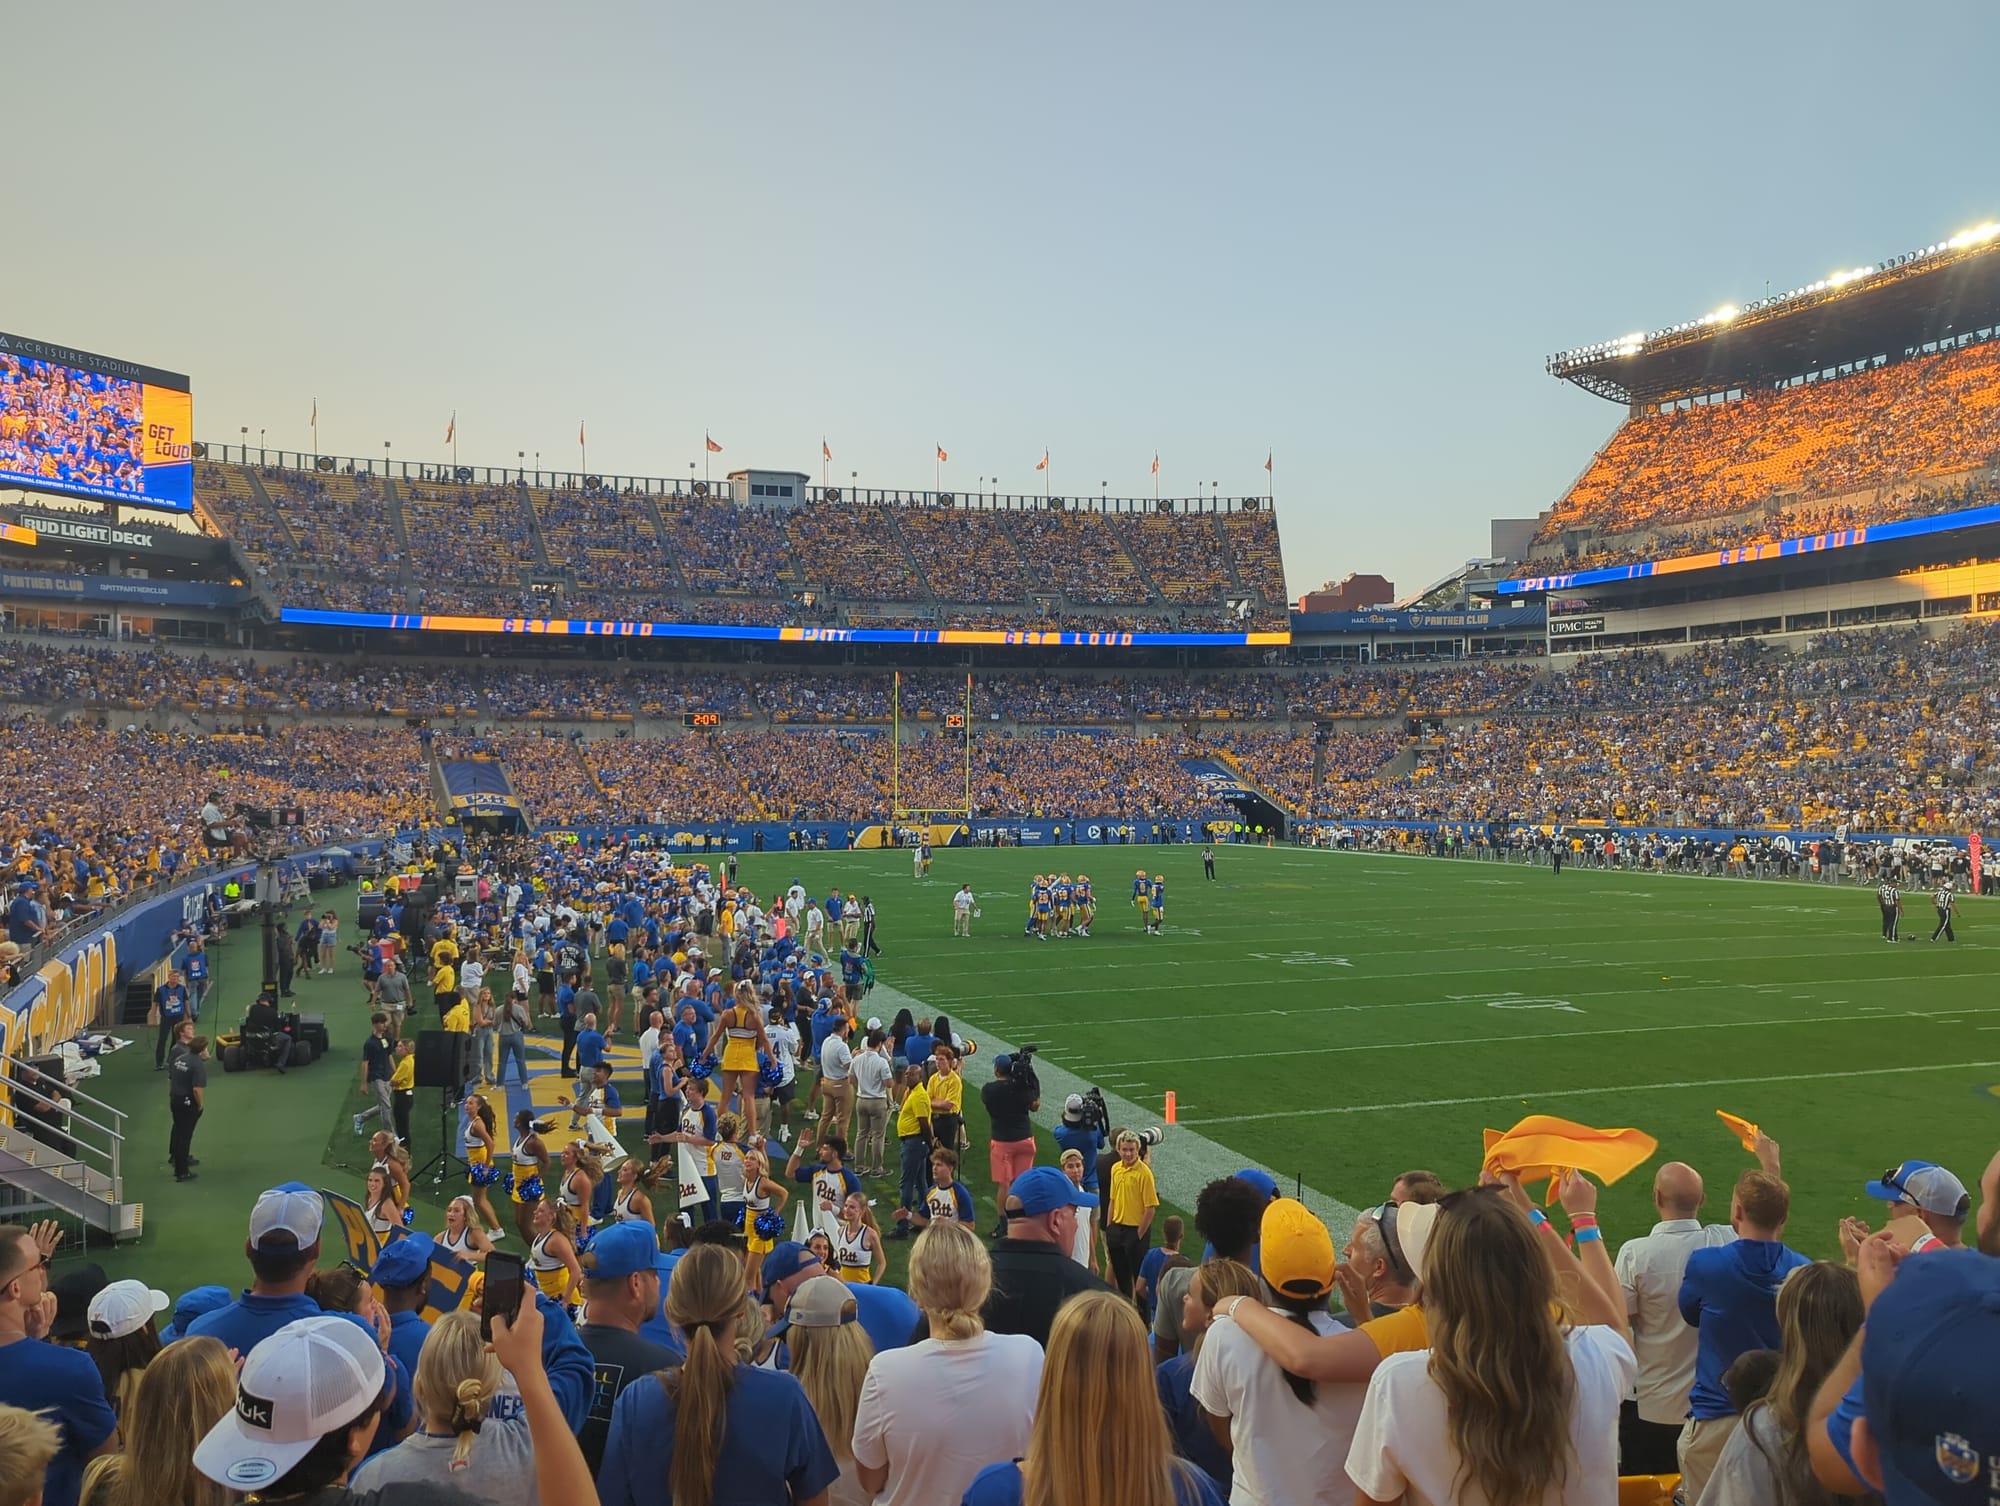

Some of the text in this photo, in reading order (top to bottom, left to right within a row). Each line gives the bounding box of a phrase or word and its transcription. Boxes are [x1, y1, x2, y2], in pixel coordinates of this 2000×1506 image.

[15, 341, 141, 377] ACRISURE STADIUM
[149, 424, 175, 441] GET
[155, 440, 190, 459] LOUD
[61, 523, 107, 541] LIGHT
[112, 530, 153, 547] DECK
[1719, 529, 1867, 565] GET LOUD
[2, 574, 85, 592] PANTHER CLUB
[1523, 574, 1569, 592] PITT
[503, 618, 653, 636] GET LOUD
[1424, 614, 1489, 626] PANTHER CLUB
[1551, 621, 1582, 633] UPMC
[1004, 630, 1133, 646] GET LOUD
[948, 715, 963, 727] 25
[683, 1118, 696, 1135] Pitt
[679, 1182, 698, 1199] Pitt
[815, 1179, 837, 1202] Pitt
[929, 1198, 953, 1218] Pitt
[839, 1247, 858, 1263] Pitt
